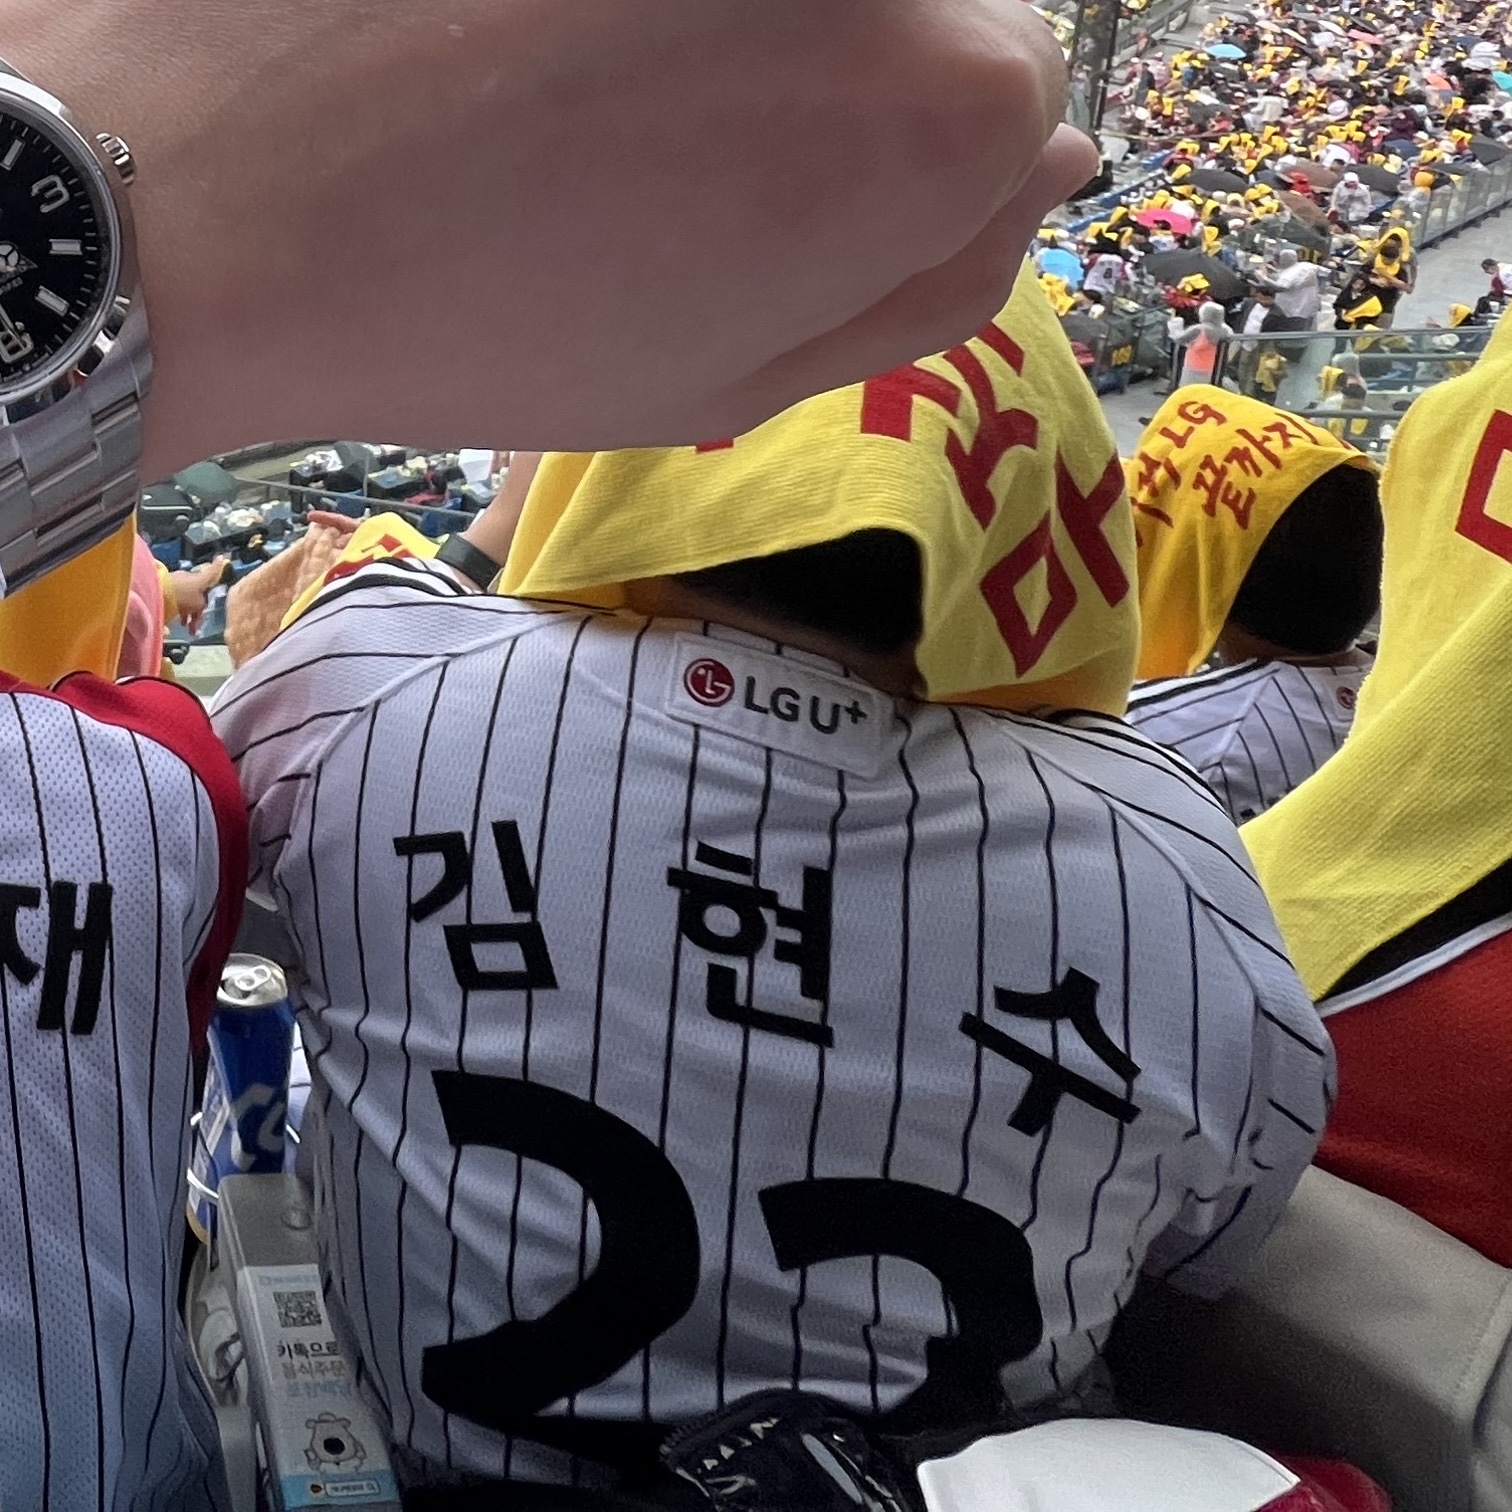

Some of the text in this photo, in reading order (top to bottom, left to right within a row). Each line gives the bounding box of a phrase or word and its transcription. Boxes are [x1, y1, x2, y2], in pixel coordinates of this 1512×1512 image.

[30, 174, 71, 214] 3
[1158, 400, 1228, 450] LG
[1192, 411, 1322, 531] 끝까지
[743, 673, 801, 723] LG
[393, 818, 1143, 1138] 김현수
